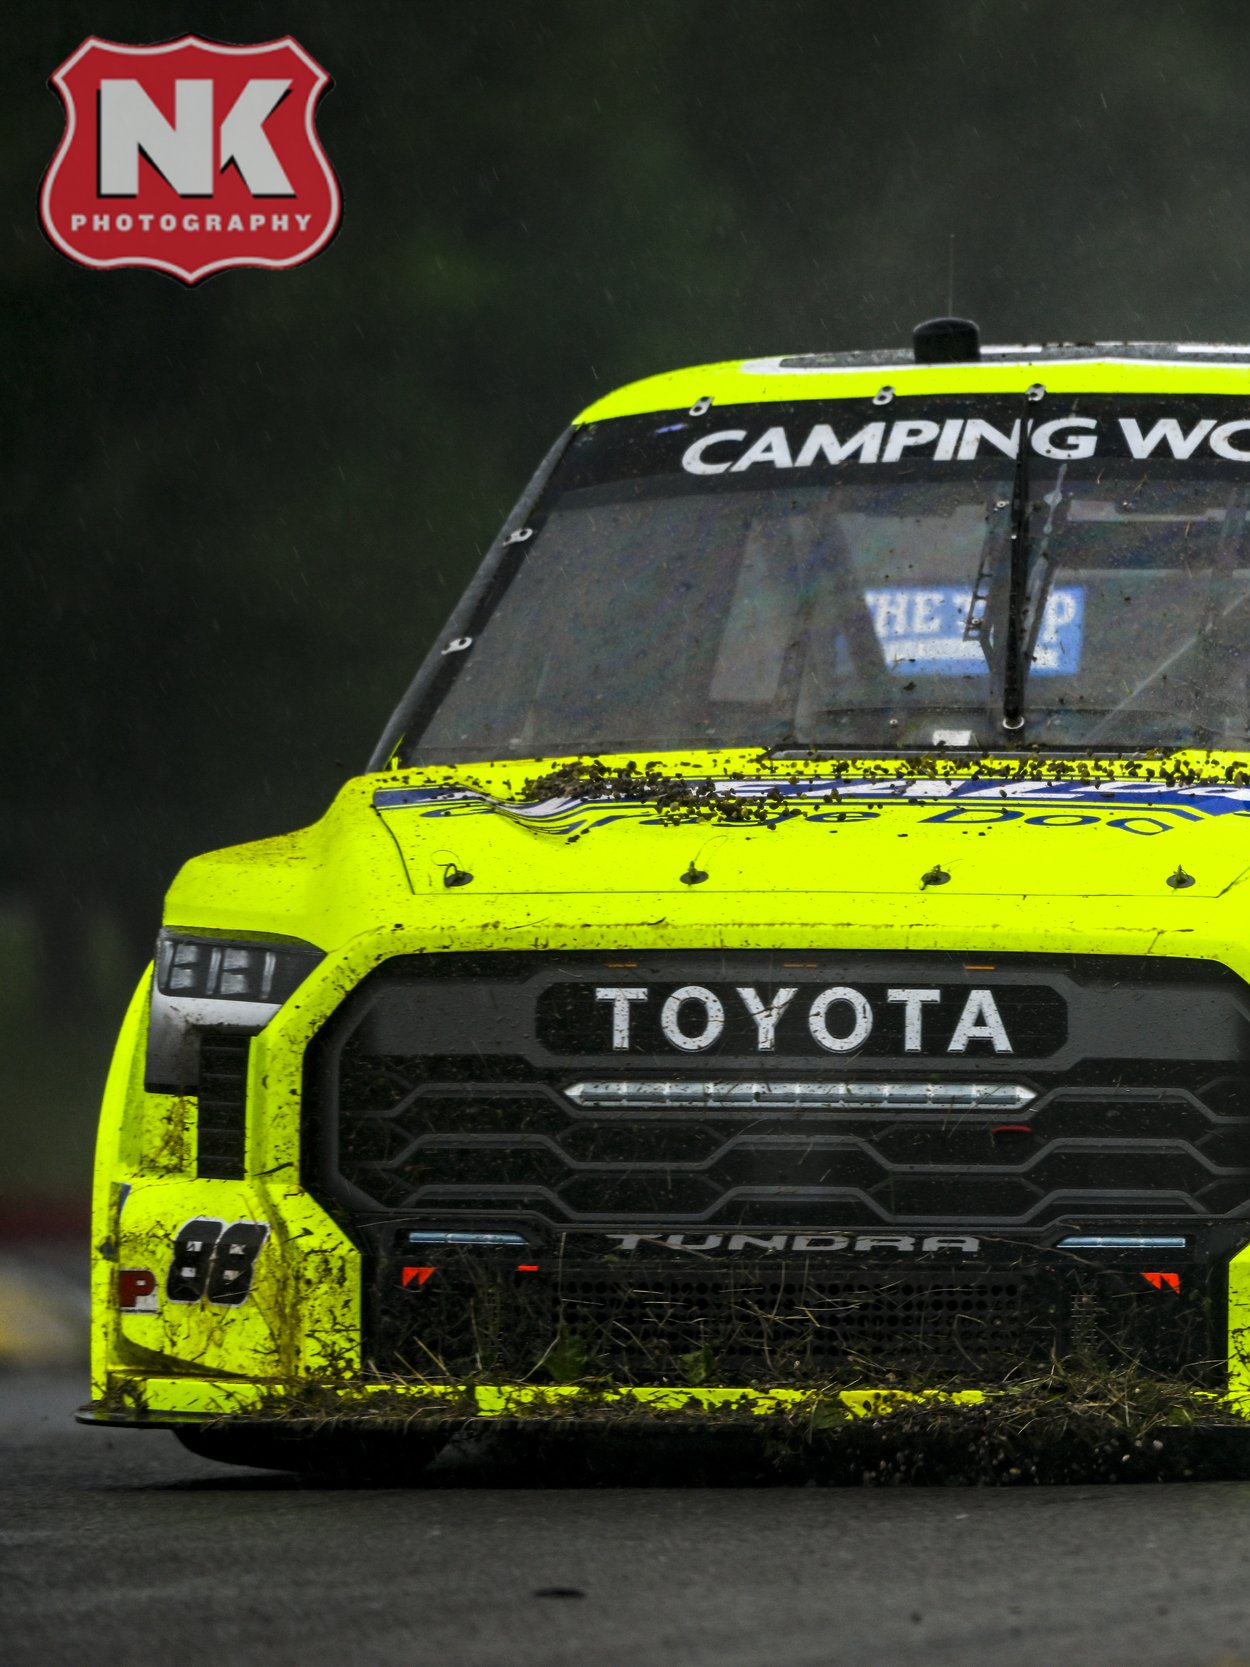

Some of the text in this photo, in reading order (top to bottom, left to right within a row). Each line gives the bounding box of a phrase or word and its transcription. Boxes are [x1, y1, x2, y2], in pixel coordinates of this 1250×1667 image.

[682, 417, 1098, 476] CAMPING
[595, 985, 1014, 1053] TOYOTA
[167, 1217, 270, 1308] 88
[605, 1232, 981, 1253] TUNDRA
